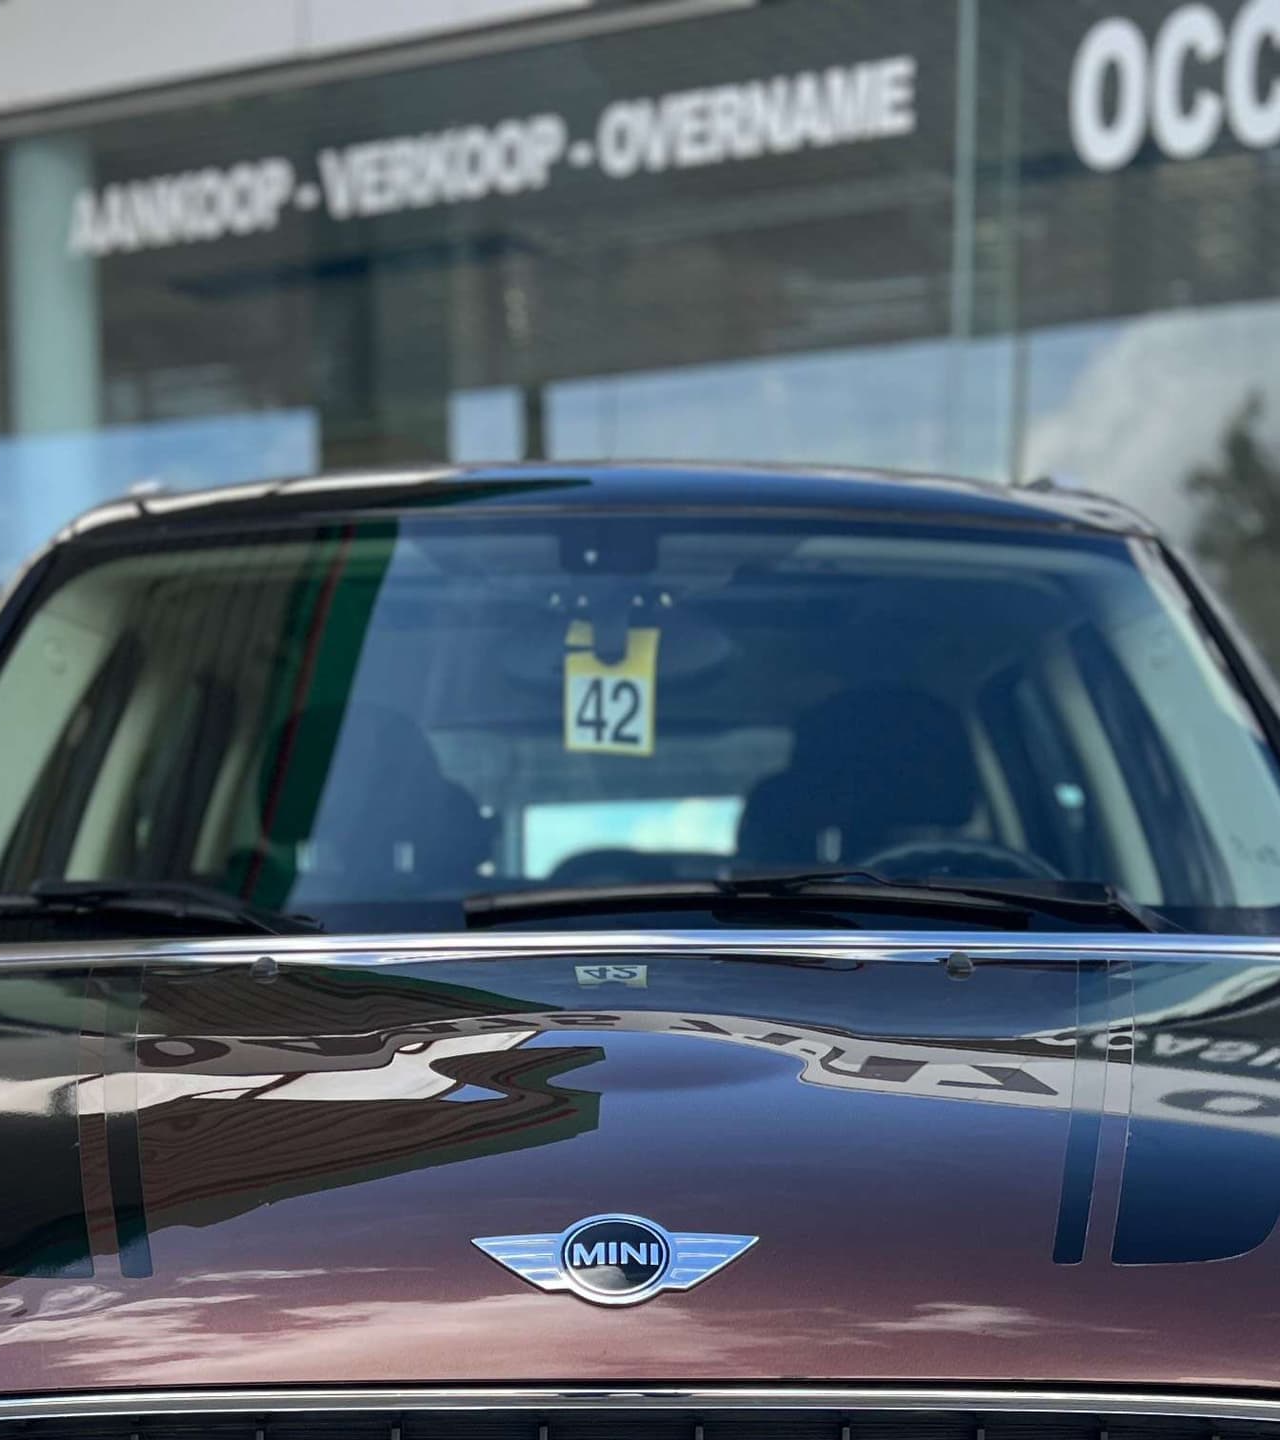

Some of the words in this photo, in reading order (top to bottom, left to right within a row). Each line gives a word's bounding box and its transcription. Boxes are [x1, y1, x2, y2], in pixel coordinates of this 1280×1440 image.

[69, 158, 293, 257] AANKOOP
[319, 112, 567, 219] VERKOOP
[597, 56, 915, 179] OVERNAME
[575, 677, 642, 746] 42
[572, 1241, 660, 1267] MINI
